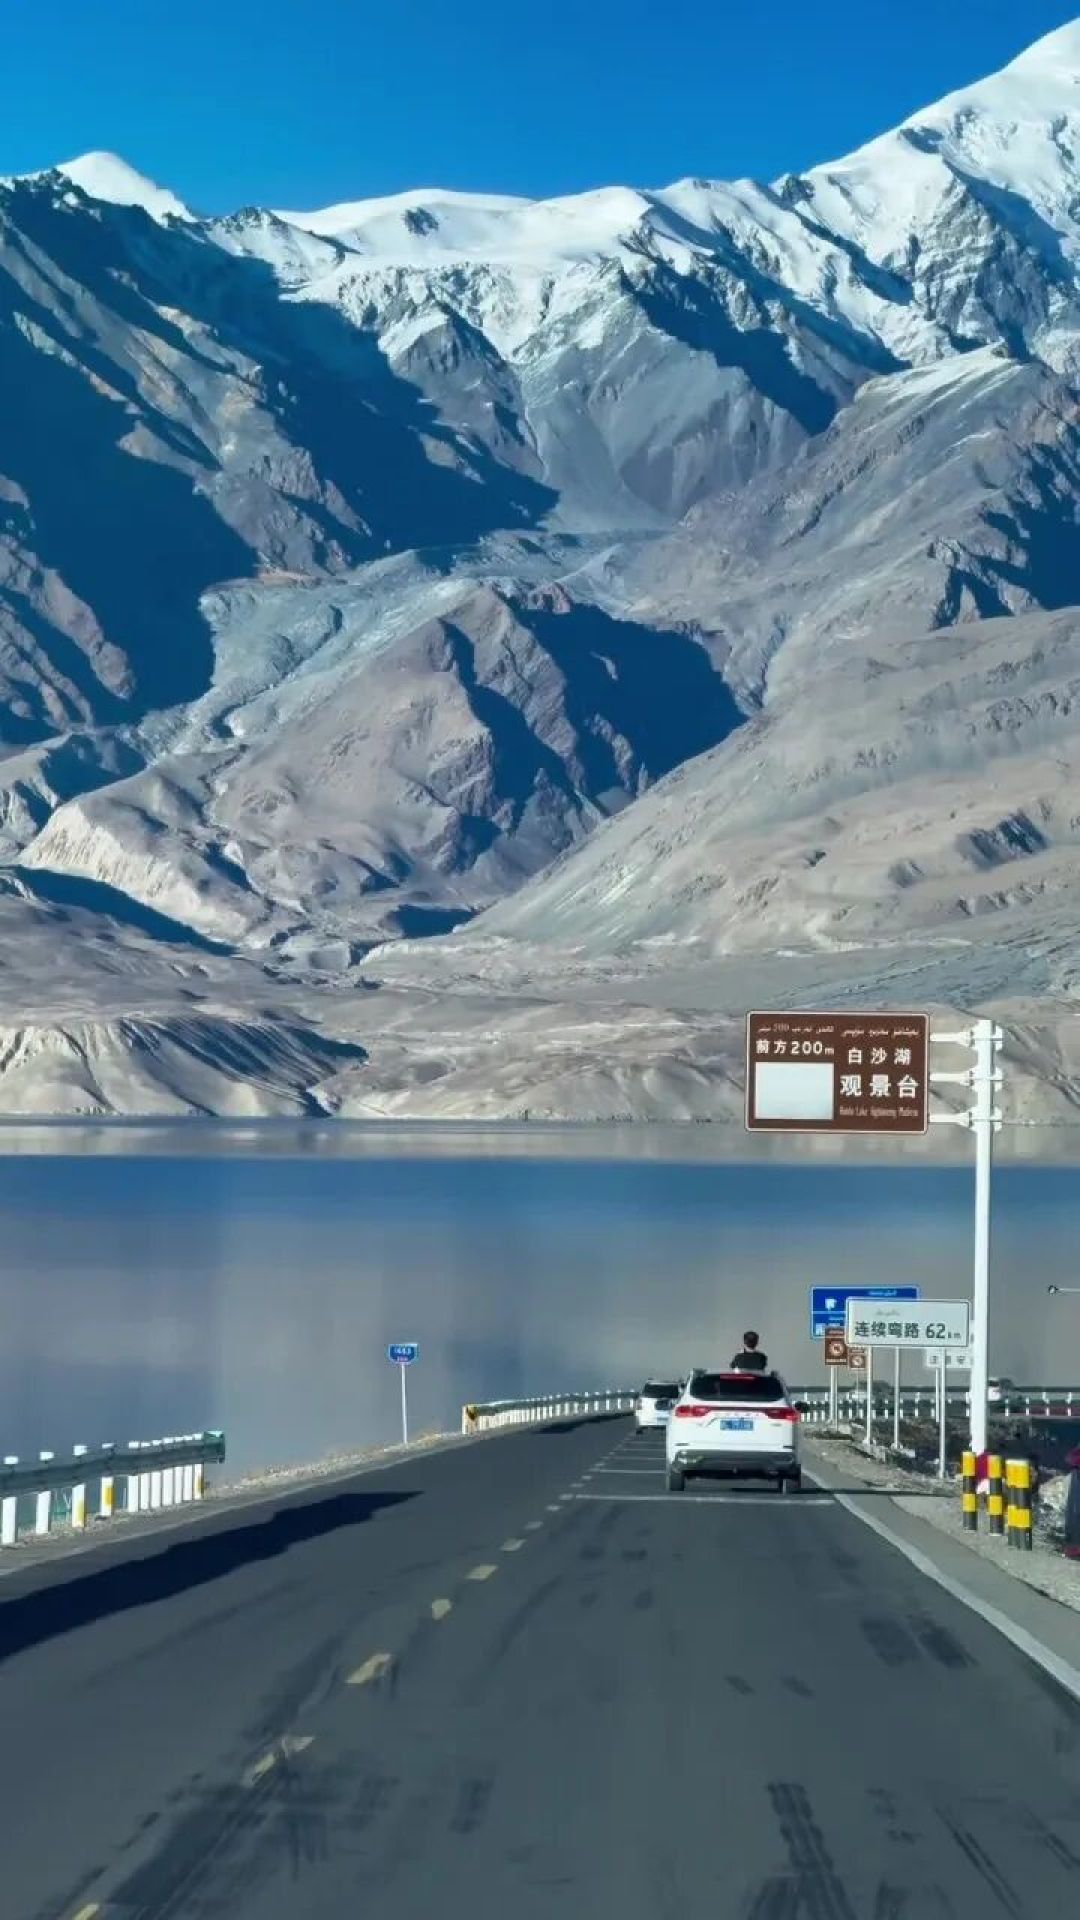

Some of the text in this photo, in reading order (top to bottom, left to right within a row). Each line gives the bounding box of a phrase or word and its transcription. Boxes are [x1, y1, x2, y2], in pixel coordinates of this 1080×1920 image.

[848, 1047, 912, 1065] 白沙湖
[840, 1074, 918, 1099] 观景台
[854, 1321, 920, 1339] 连续弯路
